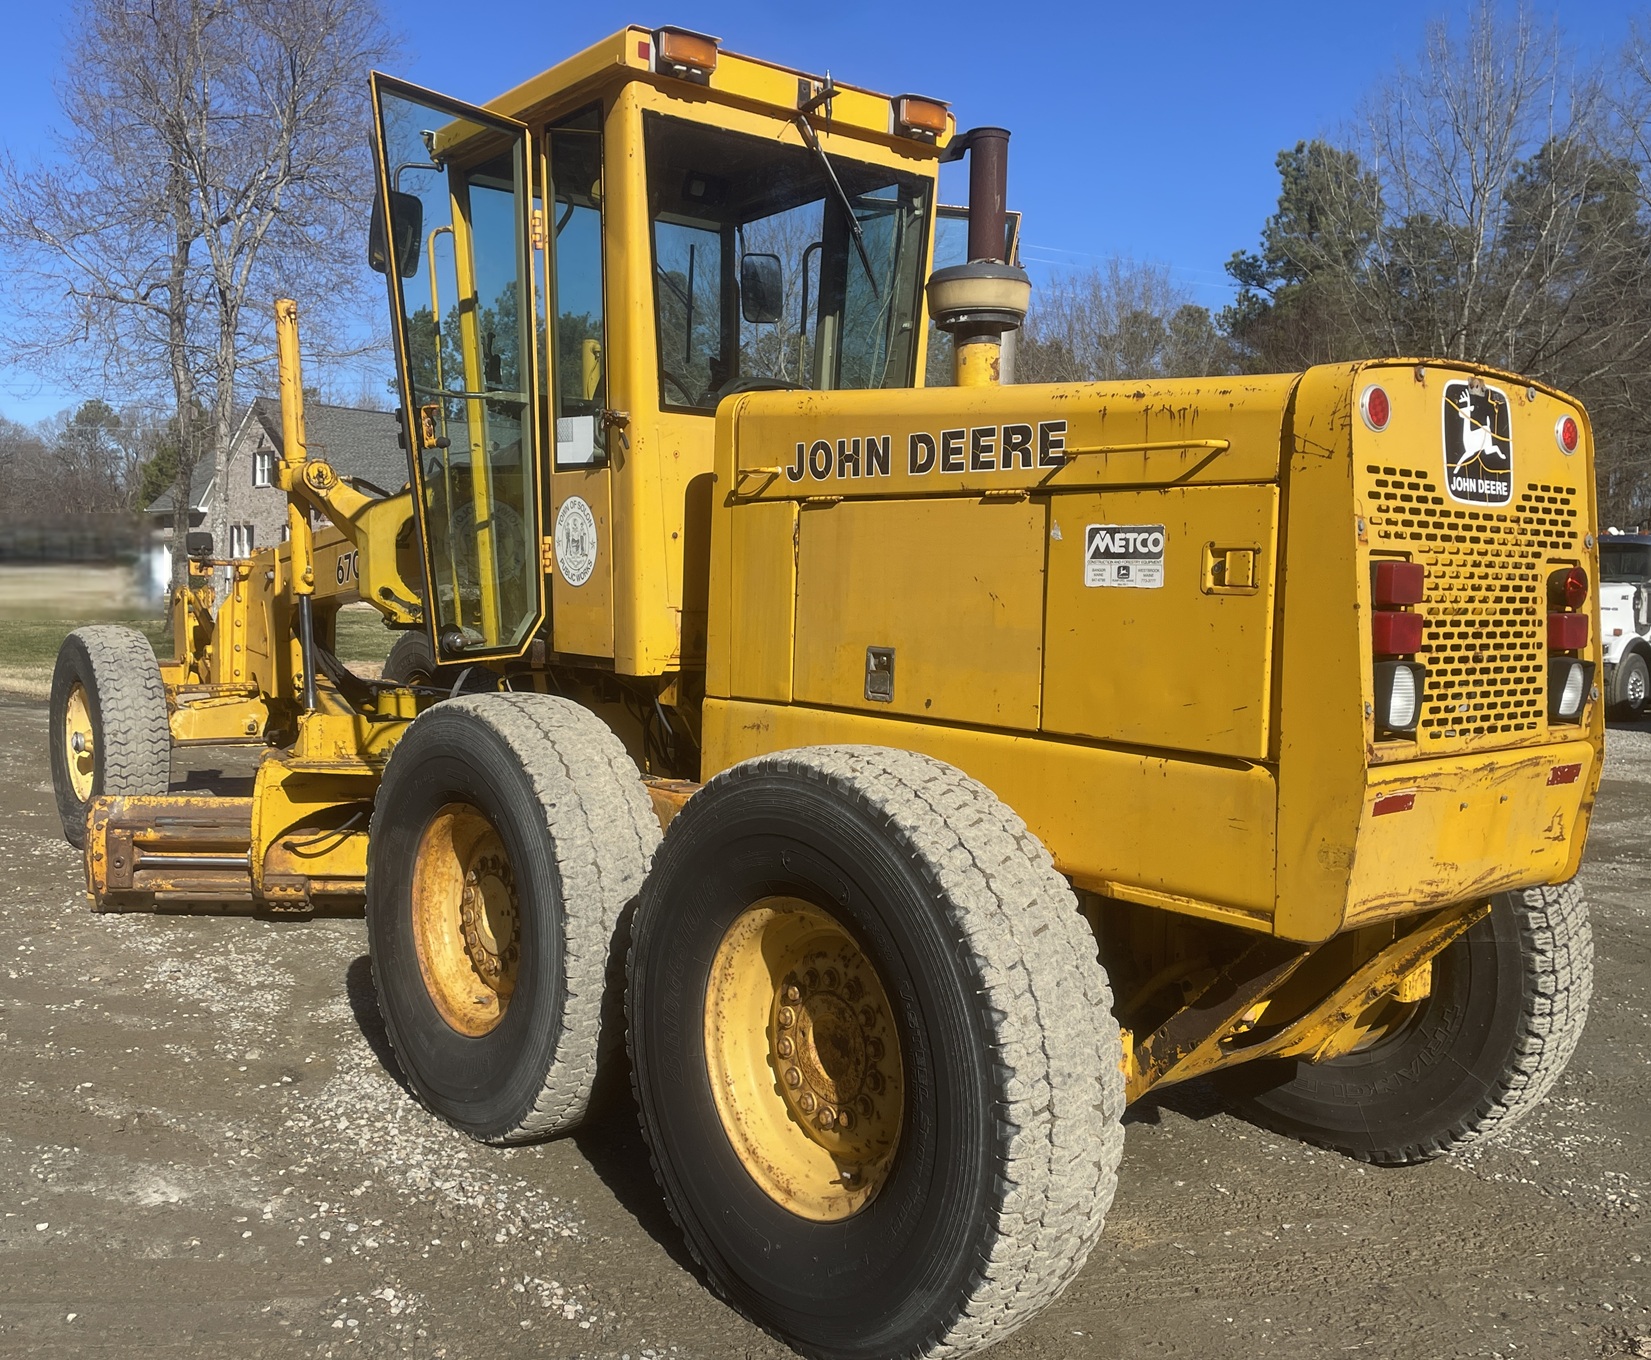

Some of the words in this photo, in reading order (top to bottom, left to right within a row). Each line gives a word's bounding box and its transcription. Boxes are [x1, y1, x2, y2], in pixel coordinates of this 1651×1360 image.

[786, 435, 891, 482] JOHN
[908, 420, 1067, 475] DEERE
[1451, 477, 1476, 492] JOHN
[1478, 480, 1508, 495] DEERE
[558, 504, 570, 527] TOWN
[570, 500, 577, 509] OF
[578, 501, 593, 527] SOLON
[1088, 531, 1164, 558] METCO
[559, 558, 575, 581] PUBLIC
[576, 559, 592, 582] WORKS
[1294, 1003, 1461, 1098] TRIANGLE
